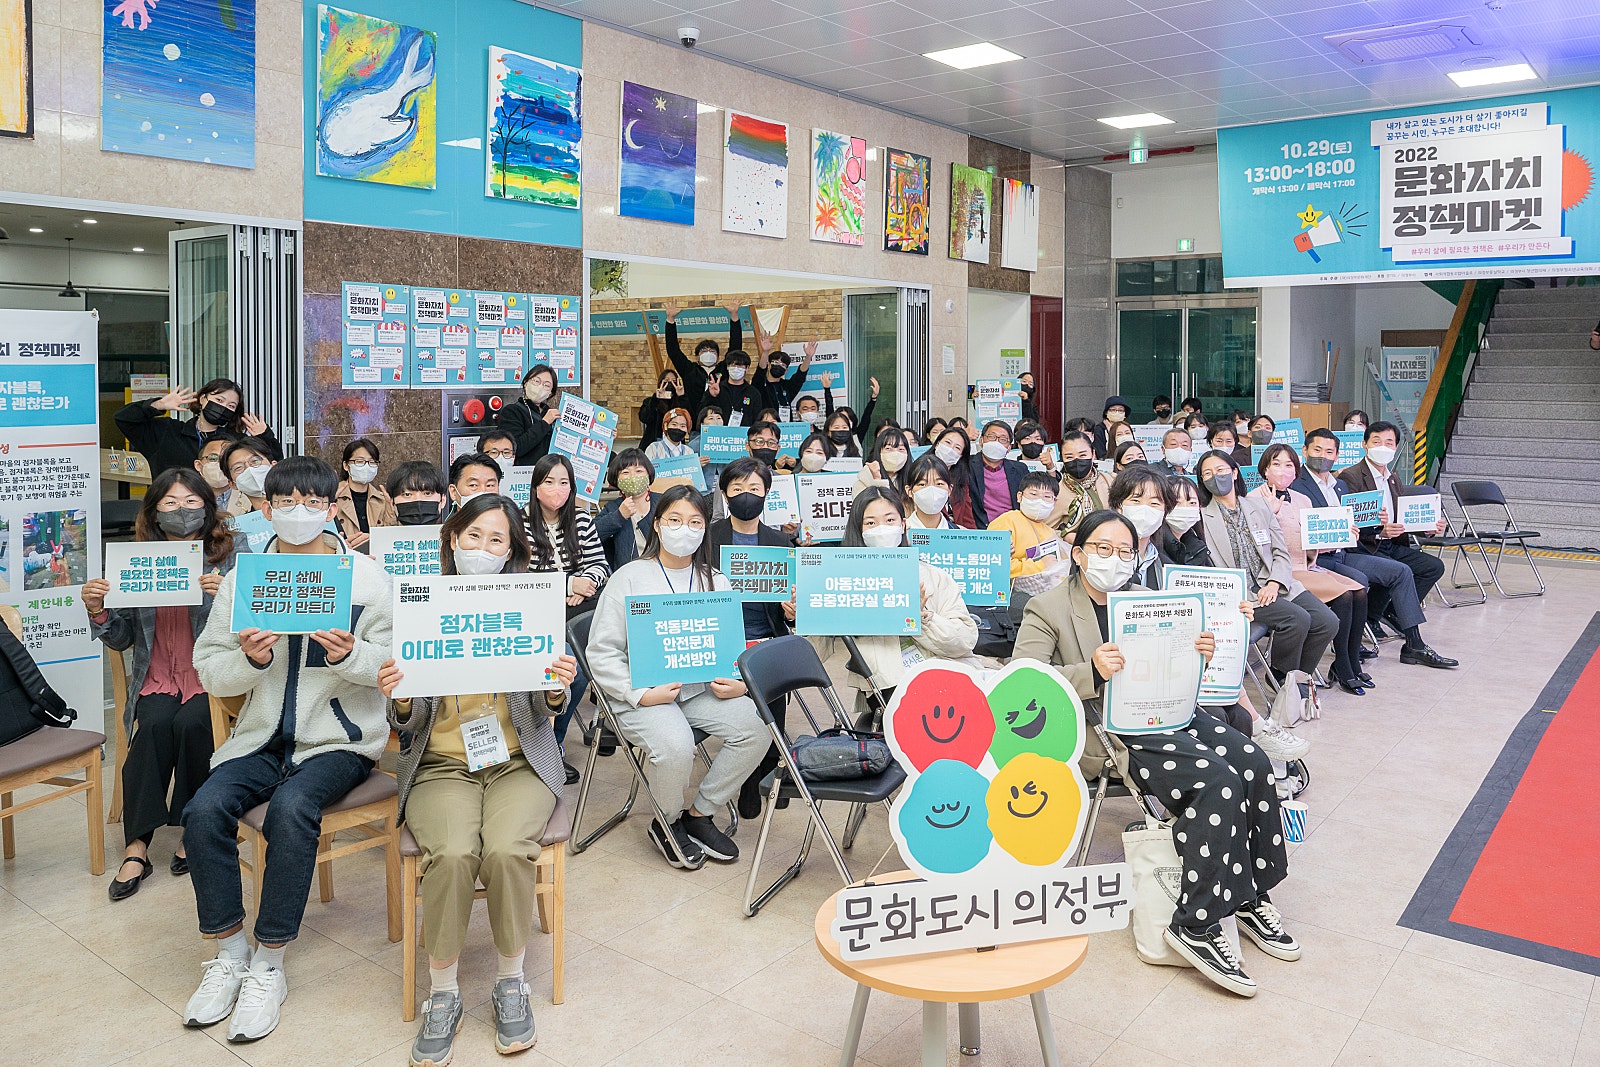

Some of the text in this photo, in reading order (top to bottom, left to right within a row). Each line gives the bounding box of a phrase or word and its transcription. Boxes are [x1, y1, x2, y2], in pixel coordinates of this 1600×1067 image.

[1386, 121, 1402, 130] 내가
[1404, 120, 1419, 129] 살고
[1421, 118, 1437, 127] 있는
[1439, 115, 1462, 125] 도시가
[1466, 114, 1473, 123] 더
[1476, 112, 1492, 121] 살기
[1386, 123, 1501, 141] 꿈꾸는 시민, 누구든 초대합니다!
[1281, 140, 1352, 159] 10.29(토)
[1395, 146, 1438, 163] 2022
[1244, 158, 1355, 182] 13:00~18:00
[1395, 156, 1542, 198] 문화자치
[1252, 185, 1275, 195] 개막식
[1278, 184, 1298, 193] 13:00
[1333, 179, 1355, 187] 17:00
[1393, 197, 1542, 237] 정책마켓
[1412, 247, 1431, 255] #우리
[1449, 245, 1470, 254] 필요한
[1472, 244, 1494, 252] 정책은
[1528, 242, 1550, 250] 만든다
[350, 297, 378, 305] 문화자치
[418, 301, 443, 309] 문화자치
[18, 343, 80, 357] 정책마켓
[12, 396, 70, 410] 괜찮은가
[565, 406, 590, 422] 문화자치
[23, 458, 56, 466] 점자블록을
[12, 476, 39, 484] 불구하고
[58, 473, 91, 482] 한가운데로
[817, 488, 834, 497] 정책
[768, 501, 787, 511] 정책
[1308, 519, 1348, 531] 문화자치
[1308, 532, 1349, 544] 정책마켓
[393, 540, 415, 551] 우리
[130, 556, 177, 568] 우리 삶에
[384, 553, 417, 564] 필요한
[956, 553, 1002, 566] 노동의식
[120, 567, 189, 580] 필요한 정책은
[384, 564, 417, 575] 우리가
[731, 561, 788, 575] 문화자치
[968, 568, 991, 580] 위한
[265, 570, 322, 584] 우리 삶에
[120, 580, 189, 592] 우리가 만든다
[825, 577, 894, 591] 아동친화적
[970, 582, 992, 594] 개선
[252, 586, 336, 599] 필요한 정책은
[400, 594, 429, 602] 정책마켓
[28, 596, 74, 609] 제안내용
[251, 601, 336, 614] 우리가 만든다
[810, 594, 910, 608] 공중화장실 설치
[1125, 608, 1193, 619] 문화도시 의정부 처방전
[31, 624, 45, 632] 상황
[440, 612, 522, 634] 점자블록
[654, 617, 720, 635] 전동킥보드
[35, 632, 48, 640] 관리
[51, 630, 71, 638] 표준안
[402, 634, 554, 660] 이대로 괜찮은가
[663, 634, 715, 651] 안전문제
[664, 651, 716, 669] 개선방안
[468, 735, 498, 750] SELLER
[839, 873, 1128, 952] 문화도시 의정부
